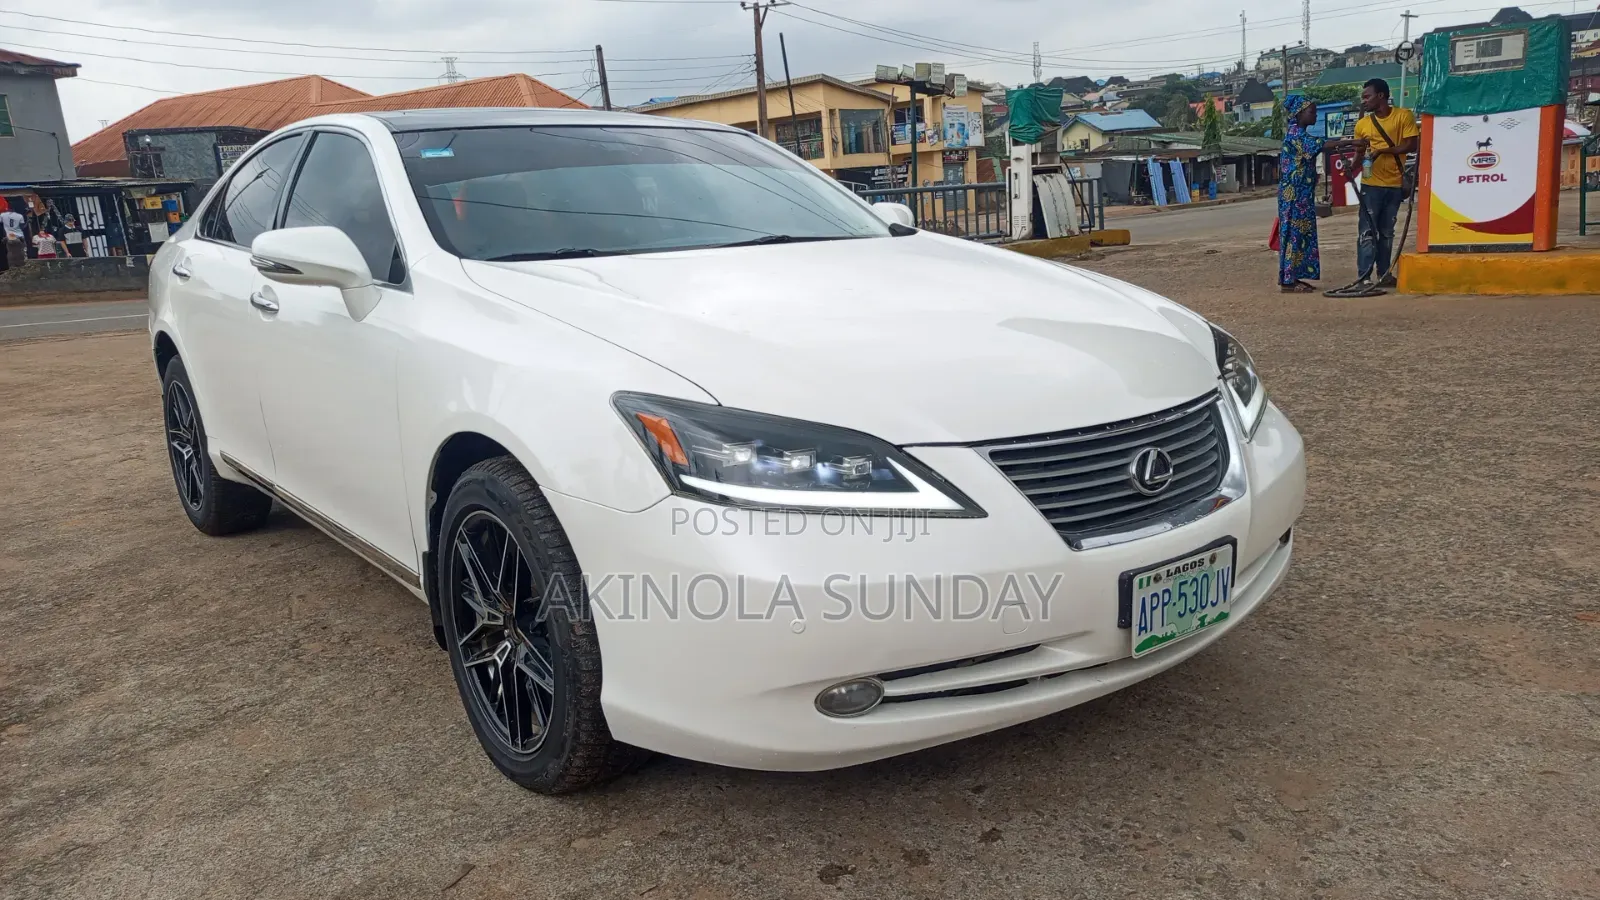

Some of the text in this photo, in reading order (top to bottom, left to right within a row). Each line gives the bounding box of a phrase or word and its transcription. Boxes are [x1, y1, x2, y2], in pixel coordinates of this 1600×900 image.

[1470, 156, 1497, 165] MRS
[1458, 173, 1507, 184] PETROL
[1165, 558, 1205, 578] LAGOS
